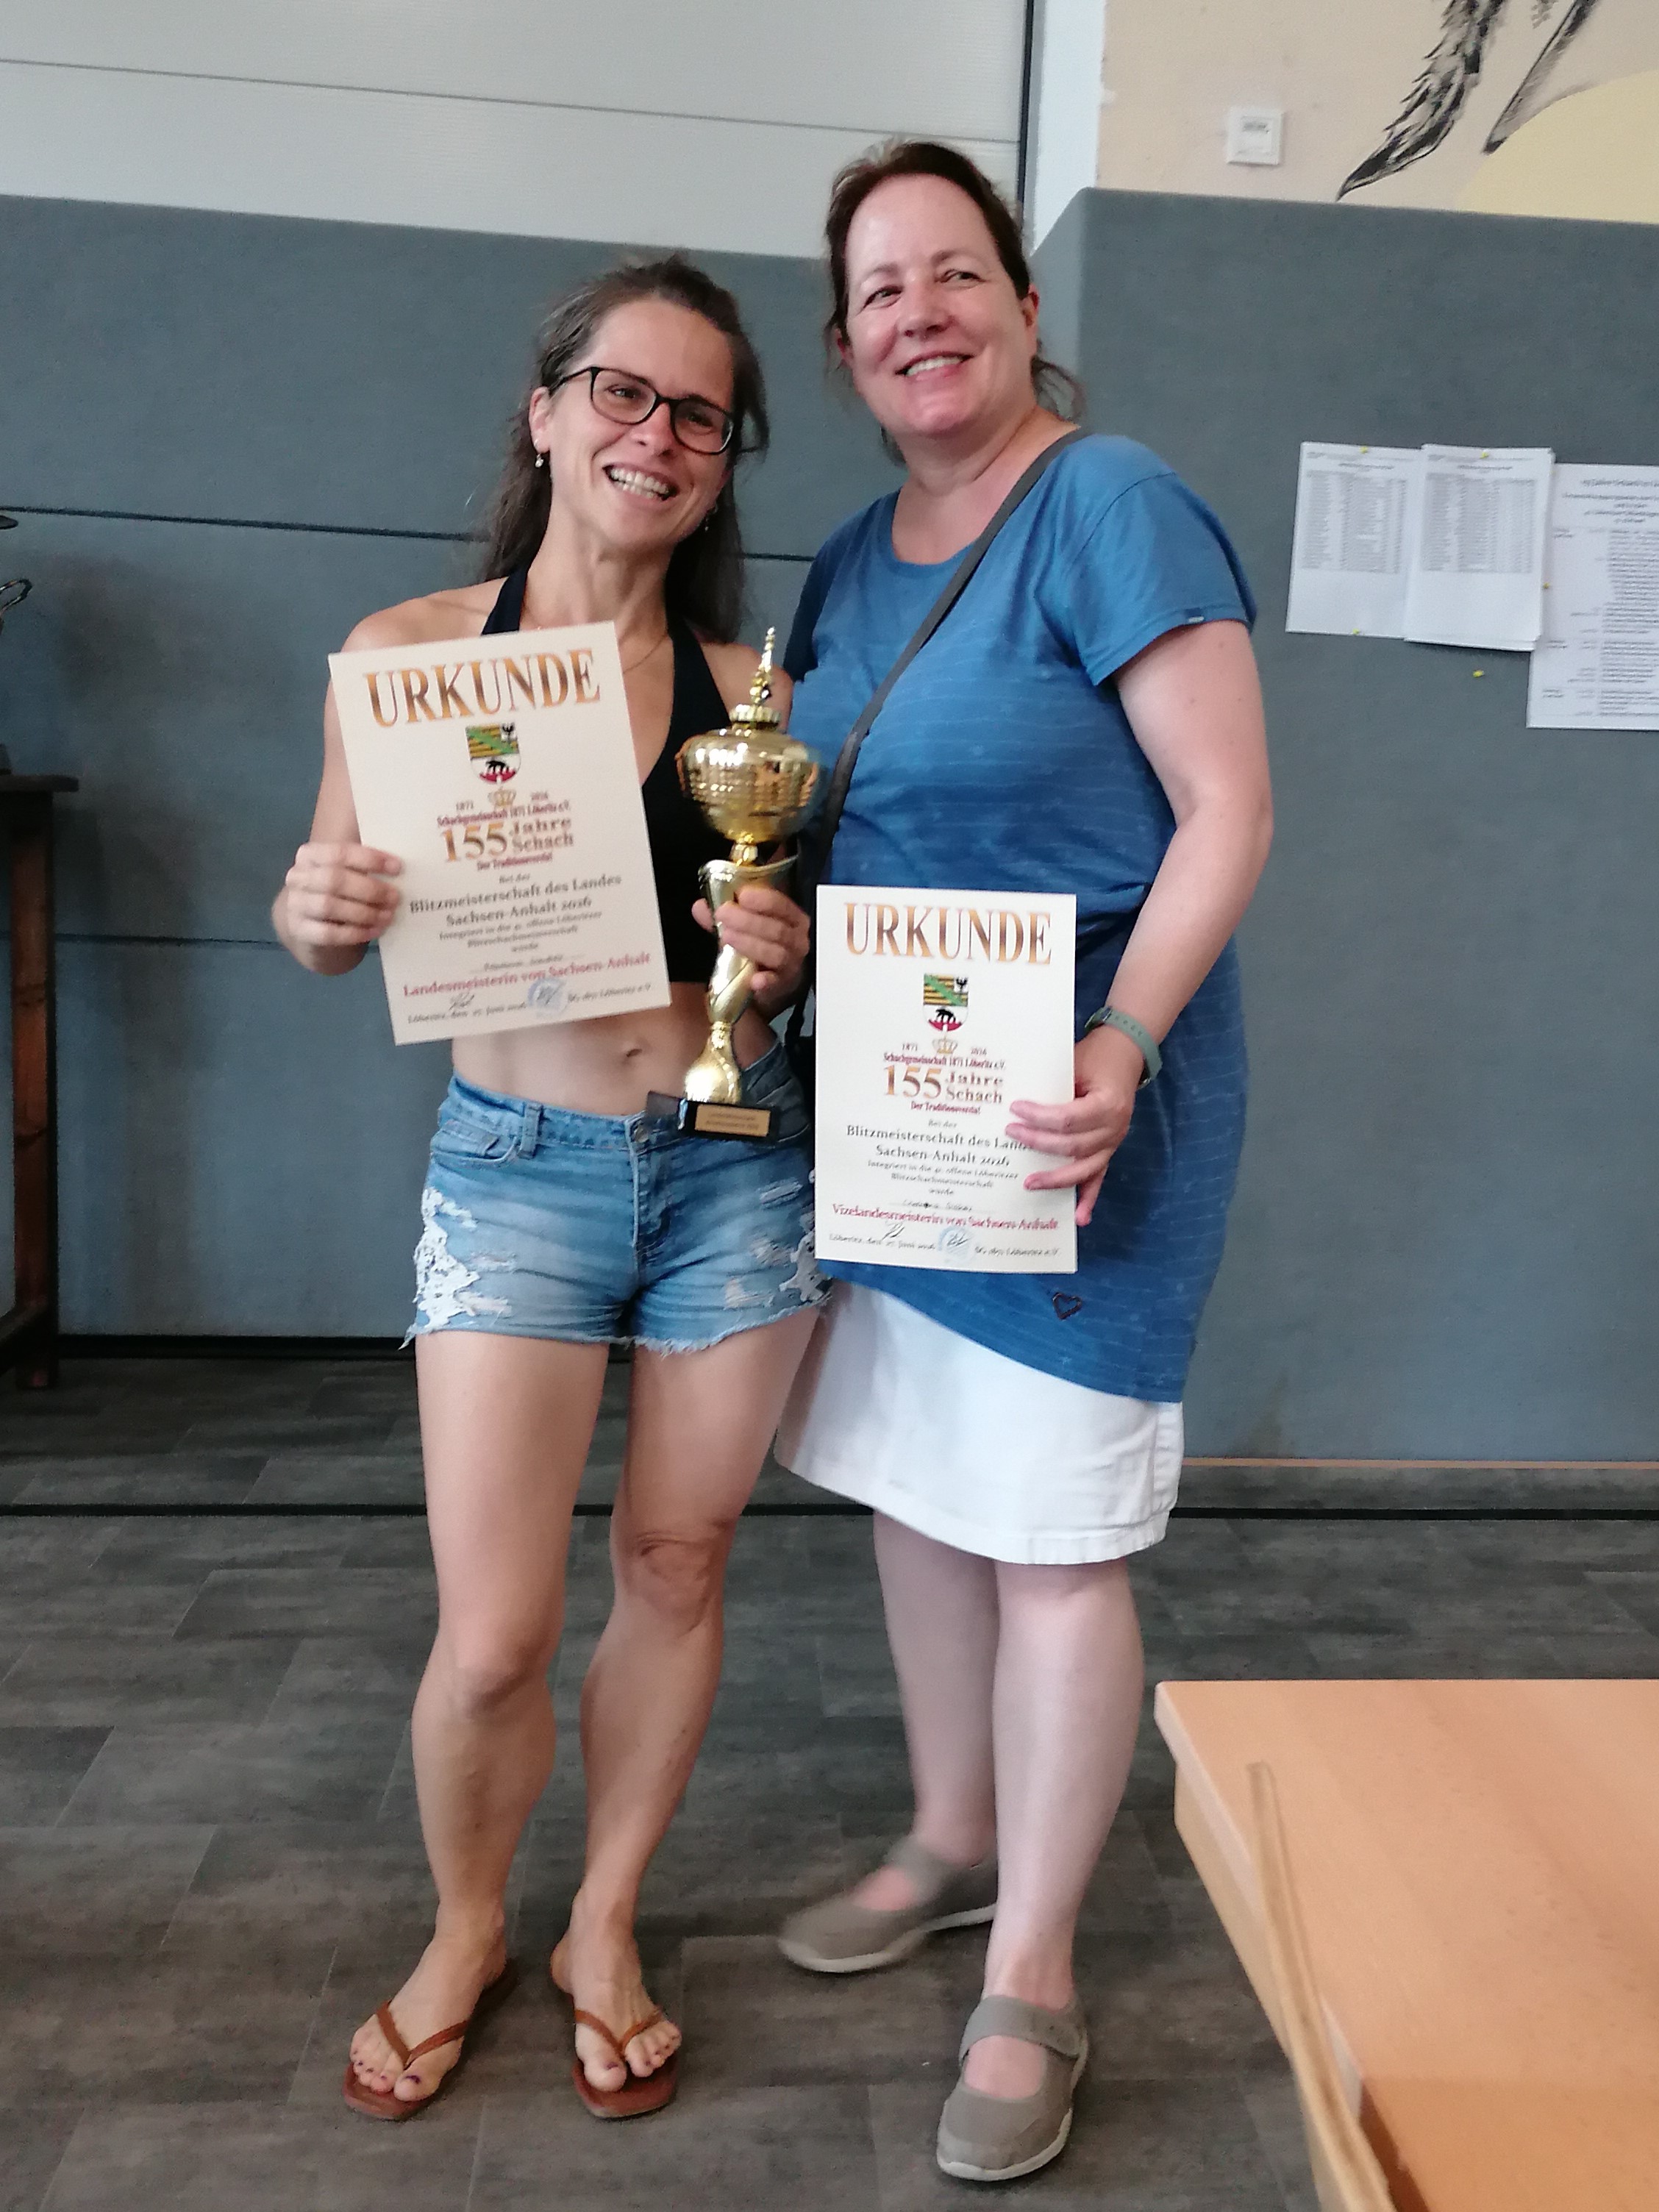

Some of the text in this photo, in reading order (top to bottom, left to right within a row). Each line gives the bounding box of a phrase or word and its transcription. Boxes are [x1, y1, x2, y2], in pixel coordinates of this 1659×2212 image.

[363, 646, 601, 728] URKUNDE
[442, 818, 571, 862] 155 Jahre
[512, 832, 574, 852] Schach
[410, 874, 622, 913] Blitzmeisterschaft des Landes
[843, 901, 1052, 966] URKUNDE
[404, 972, 518, 996] Landesmeisterin
[521, 969, 546, 982] von
[902, 1041, 918, 1052] 1871
[883, 1064, 1003, 1099] 155 Jahre
[945, 1085, 1002, 1104] Schach
[847, 1124, 964, 1145] Blitzmeisterschaft
[968, 1135, 991, 1147] des
[832, 1203, 943, 1224] Vizelandesmeisterin
[946, 1216, 966, 1226] von
